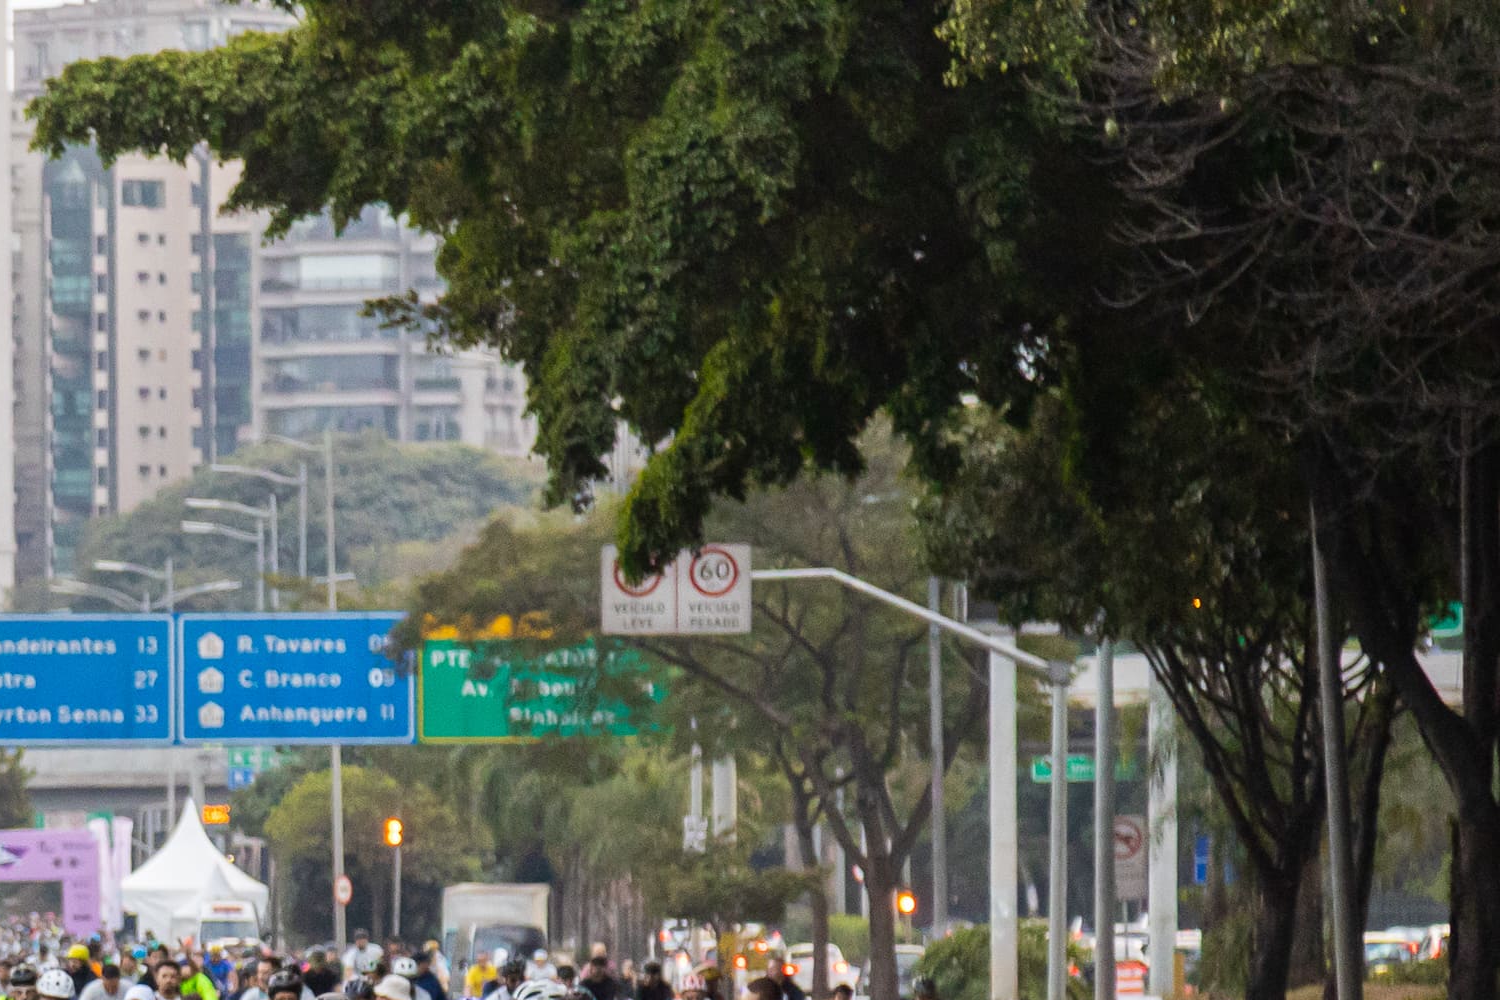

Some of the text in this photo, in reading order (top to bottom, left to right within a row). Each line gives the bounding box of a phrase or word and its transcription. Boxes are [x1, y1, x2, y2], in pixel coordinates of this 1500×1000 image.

[701, 559, 731, 581] 60
[137, 636, 158, 654] 13
[237, 634, 259, 654] R.
[263, 635, 347, 654] Tavares
[430, 649, 471, 669] PTE
[134, 670, 158, 689] 27
[238, 669, 258, 689] C.
[264, 669, 342, 688] Branco
[461, 680, 493, 698] Av.
[57, 704, 125, 724] Senna
[134, 704, 159, 724] 33
[240, 703, 395, 727] Anhanguera 11
